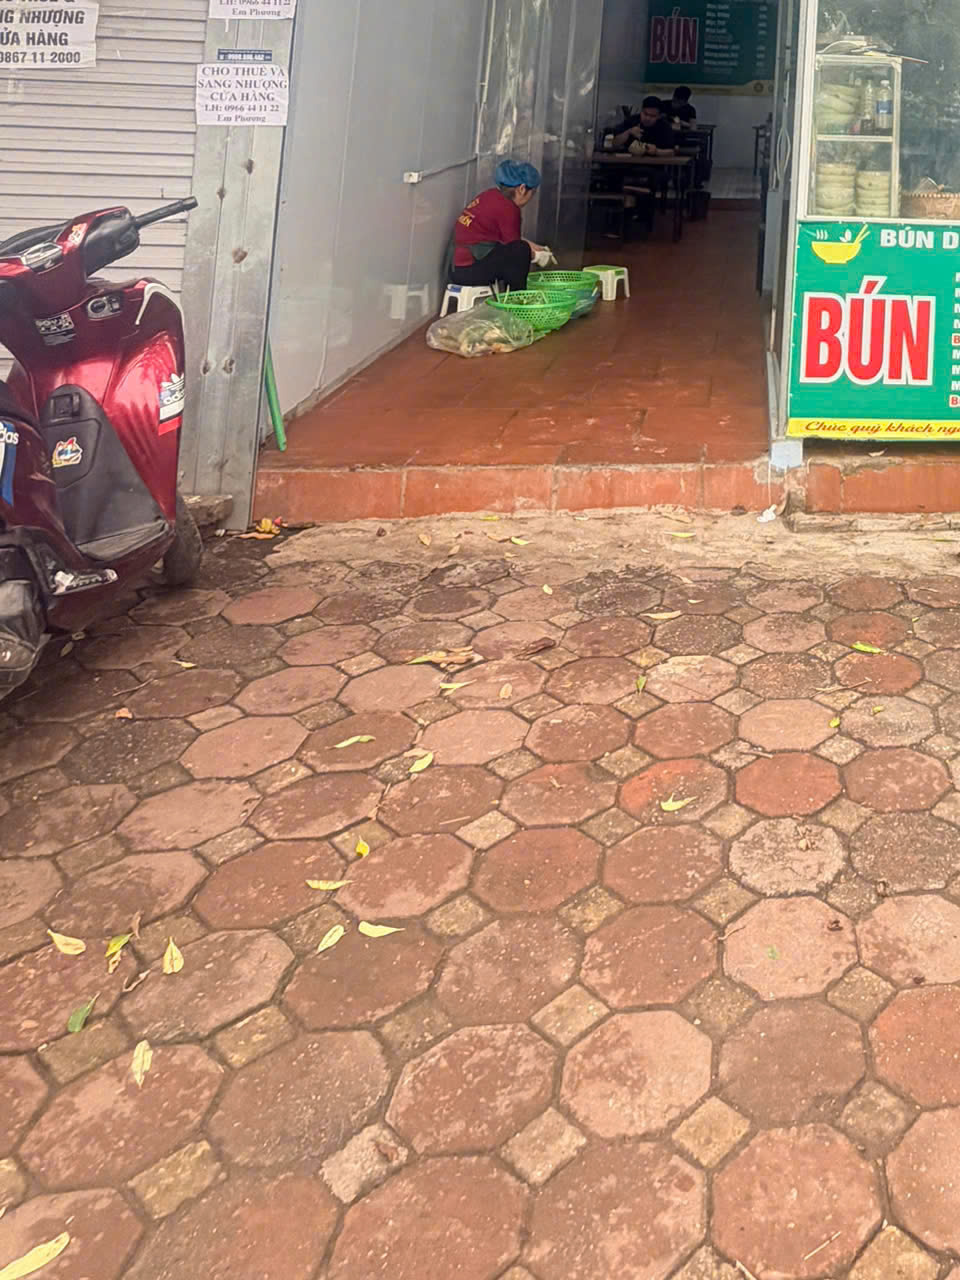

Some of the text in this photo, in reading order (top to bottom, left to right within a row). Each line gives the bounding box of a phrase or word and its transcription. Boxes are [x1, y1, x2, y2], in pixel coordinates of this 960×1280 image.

[19, 9, 85, 27] NHƯỢNG
[26, 29, 69, 46] HÀNG
[650, 6, 699, 64] BÚN
[32, 52, 45, 63] 11
[50, 51, 81, 63] 2000
[202, 66, 230, 76] CHO
[198, 80, 232, 88] SANG
[880, 227, 934, 249] BÚN
[800, 275, 936, 385] BÚN
